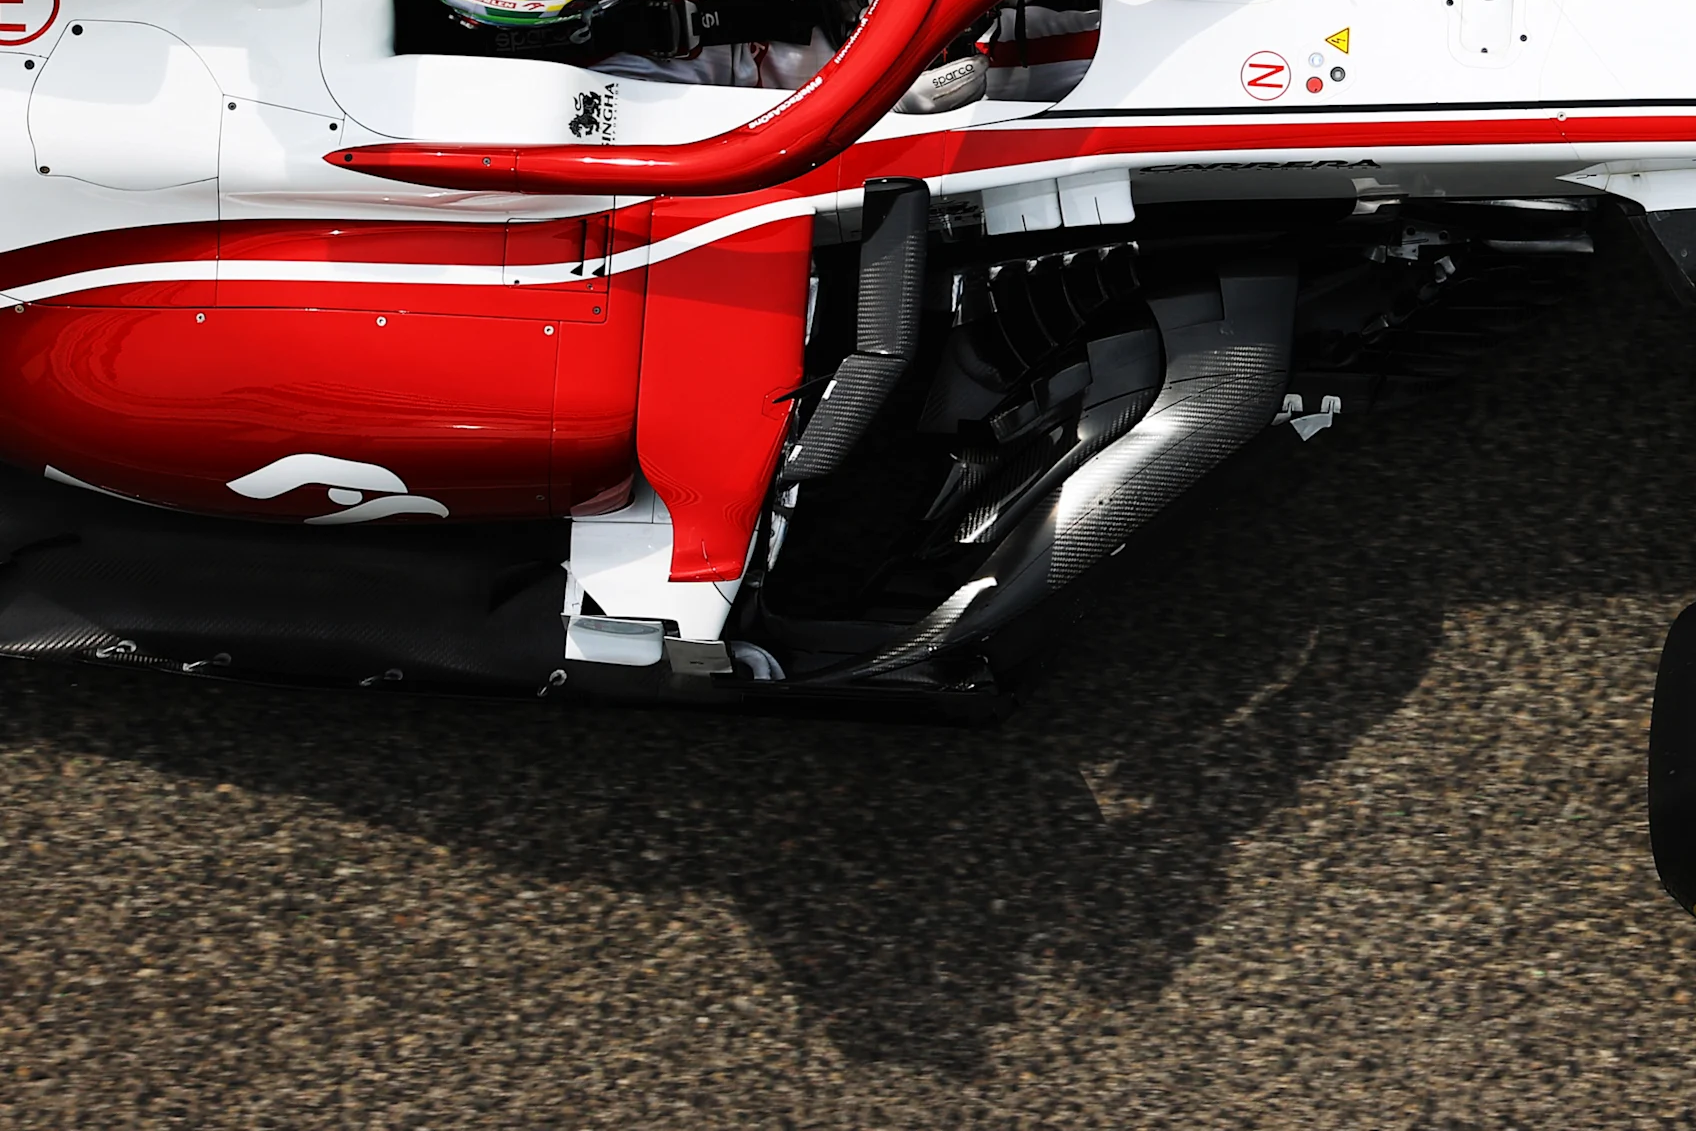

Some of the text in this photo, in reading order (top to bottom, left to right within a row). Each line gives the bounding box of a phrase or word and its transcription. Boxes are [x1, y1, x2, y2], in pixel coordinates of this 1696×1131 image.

[931, 64, 976, 88] sparco
[748, 76, 823, 129] #WeRaceAsOne
[1139, 159, 1382, 172] CARRERA
